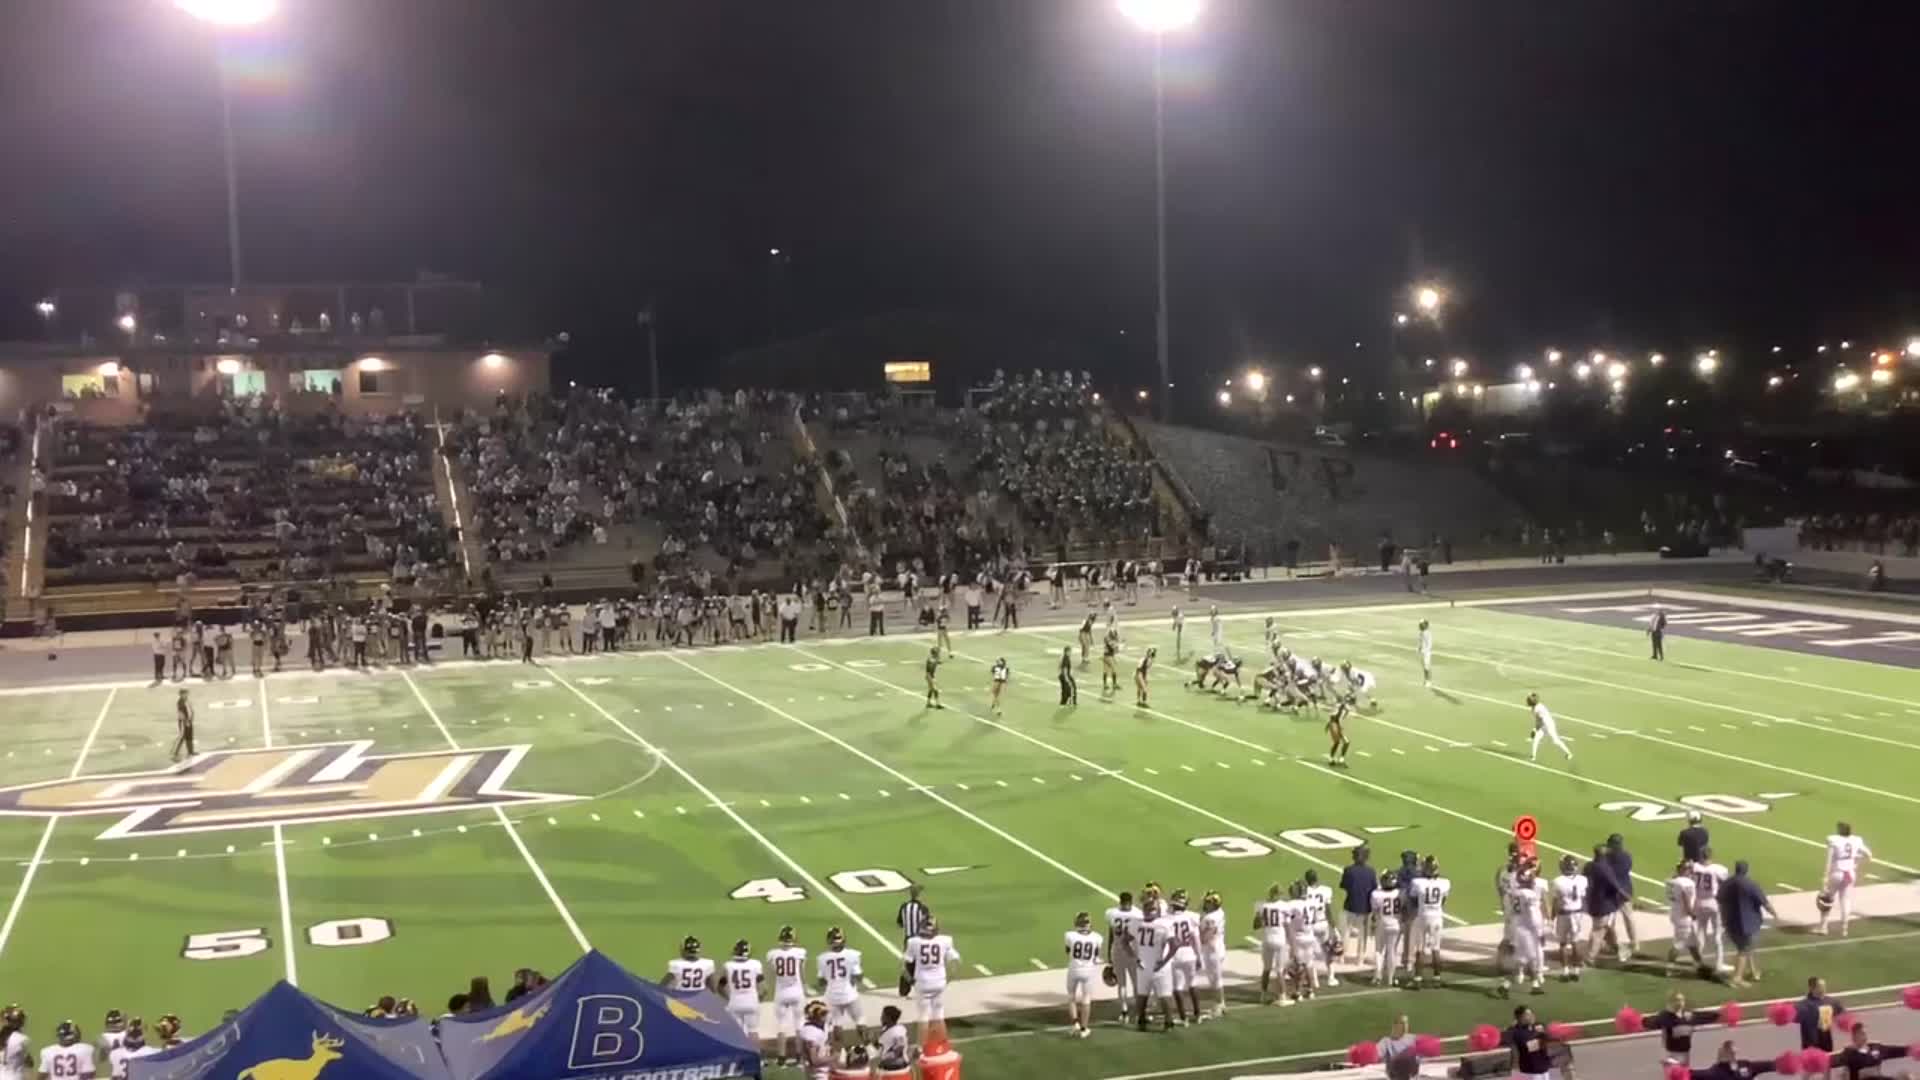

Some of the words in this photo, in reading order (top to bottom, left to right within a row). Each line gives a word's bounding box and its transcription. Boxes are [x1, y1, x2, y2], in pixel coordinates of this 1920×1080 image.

[1599, 794, 1770, 822] 20
[1188, 827, 1367, 858] 30
[731, 868, 912, 903] 40
[181, 916, 395, 960] 50
[1138, 927, 1155, 946] 77
[920, 944, 940, 965] 59
[1073, 941, 1093, 960] 89
[775, 956, 796, 977] 80
[826, 958, 848, 979] 75
[681, 968, 702, 988] 52
[731, 969, 751, 990] 45
[568, 994, 644, 1069] B
[53, 1054, 77, 1077] 63
